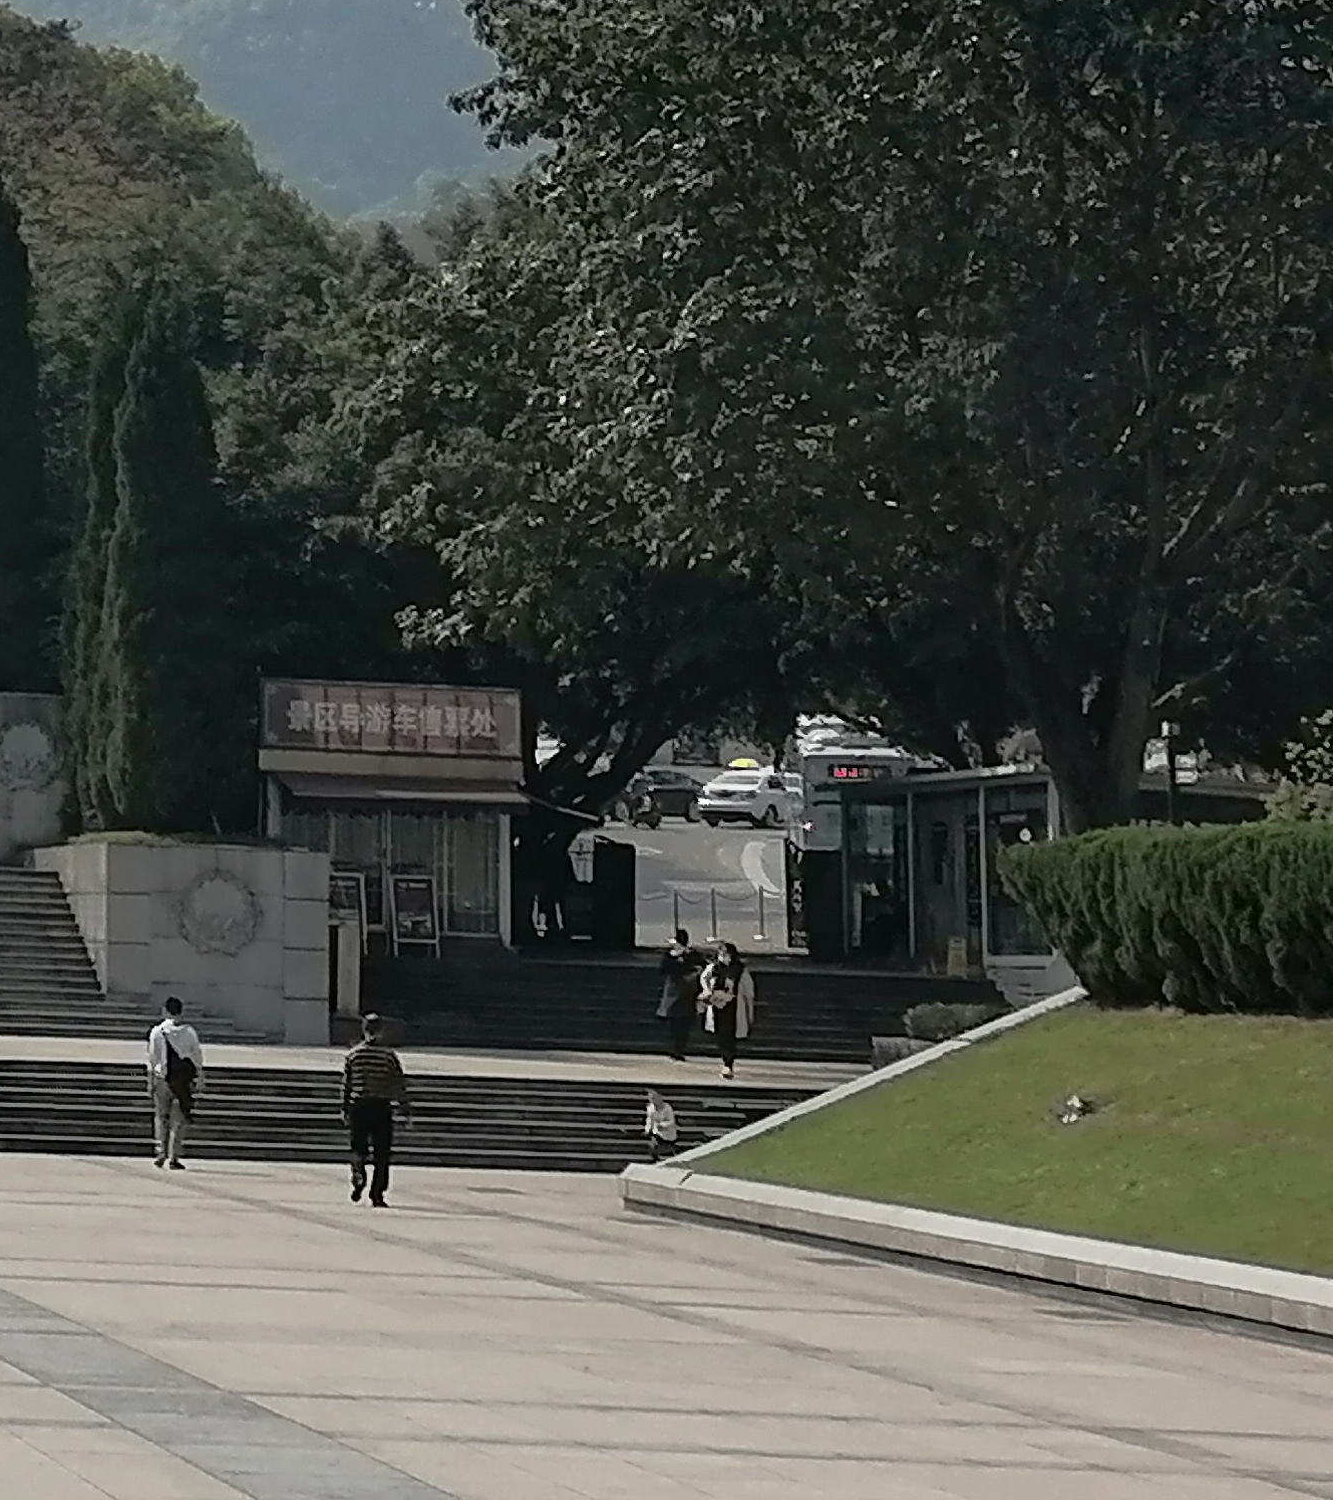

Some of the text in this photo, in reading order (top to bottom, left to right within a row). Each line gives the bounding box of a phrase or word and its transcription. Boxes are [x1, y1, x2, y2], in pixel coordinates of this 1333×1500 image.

[287, 699, 497, 740] 景区导游车售票处
